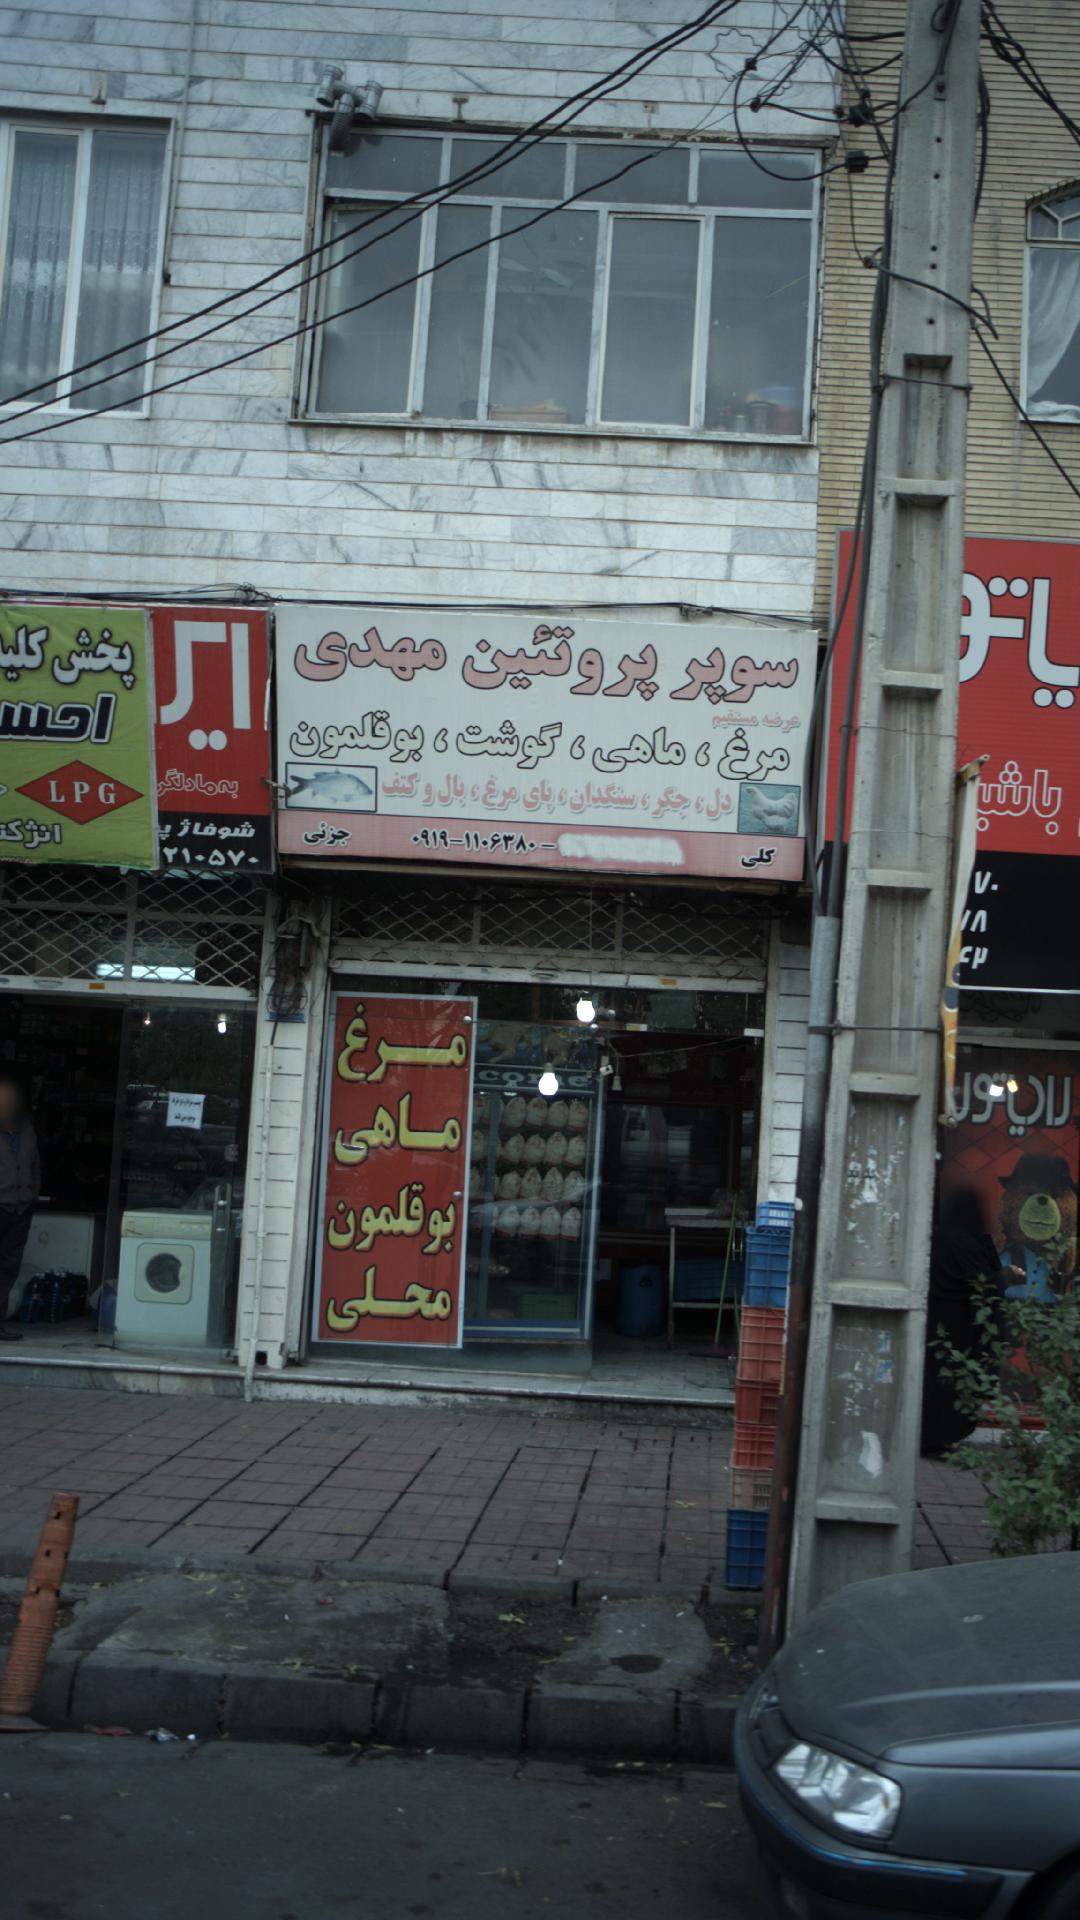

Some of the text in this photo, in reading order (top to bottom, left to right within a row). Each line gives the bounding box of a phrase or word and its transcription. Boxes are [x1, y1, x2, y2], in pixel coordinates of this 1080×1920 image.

[0, 625, 136, 690] پخش کلی
[294, 625, 799, 705] سوپر پروتئین مهدی
[0, 692, 117, 743] احس
[289, 710, 424, 762] بوقلمون
[48, 780, 117, 804] LPG
[157, 768, 195, 797] دلگر
[382, 772, 420, 797] کتف
[437, 773, 465, 807] بال
[523, 779, 555, 814] پای
[977, 760, 1062, 836] باشی
[177, 819, 255, 839] شوفاژ
[302, 823, 351, 847] جزئی
[740, 849, 775, 868] کلی
[337, 1001, 469, 1083] مرغ
[334, 1091, 462, 1165] ماهی
[326, 1182, 456, 1254] بوقلمون
[325, 1264, 452, 1332] محلی
